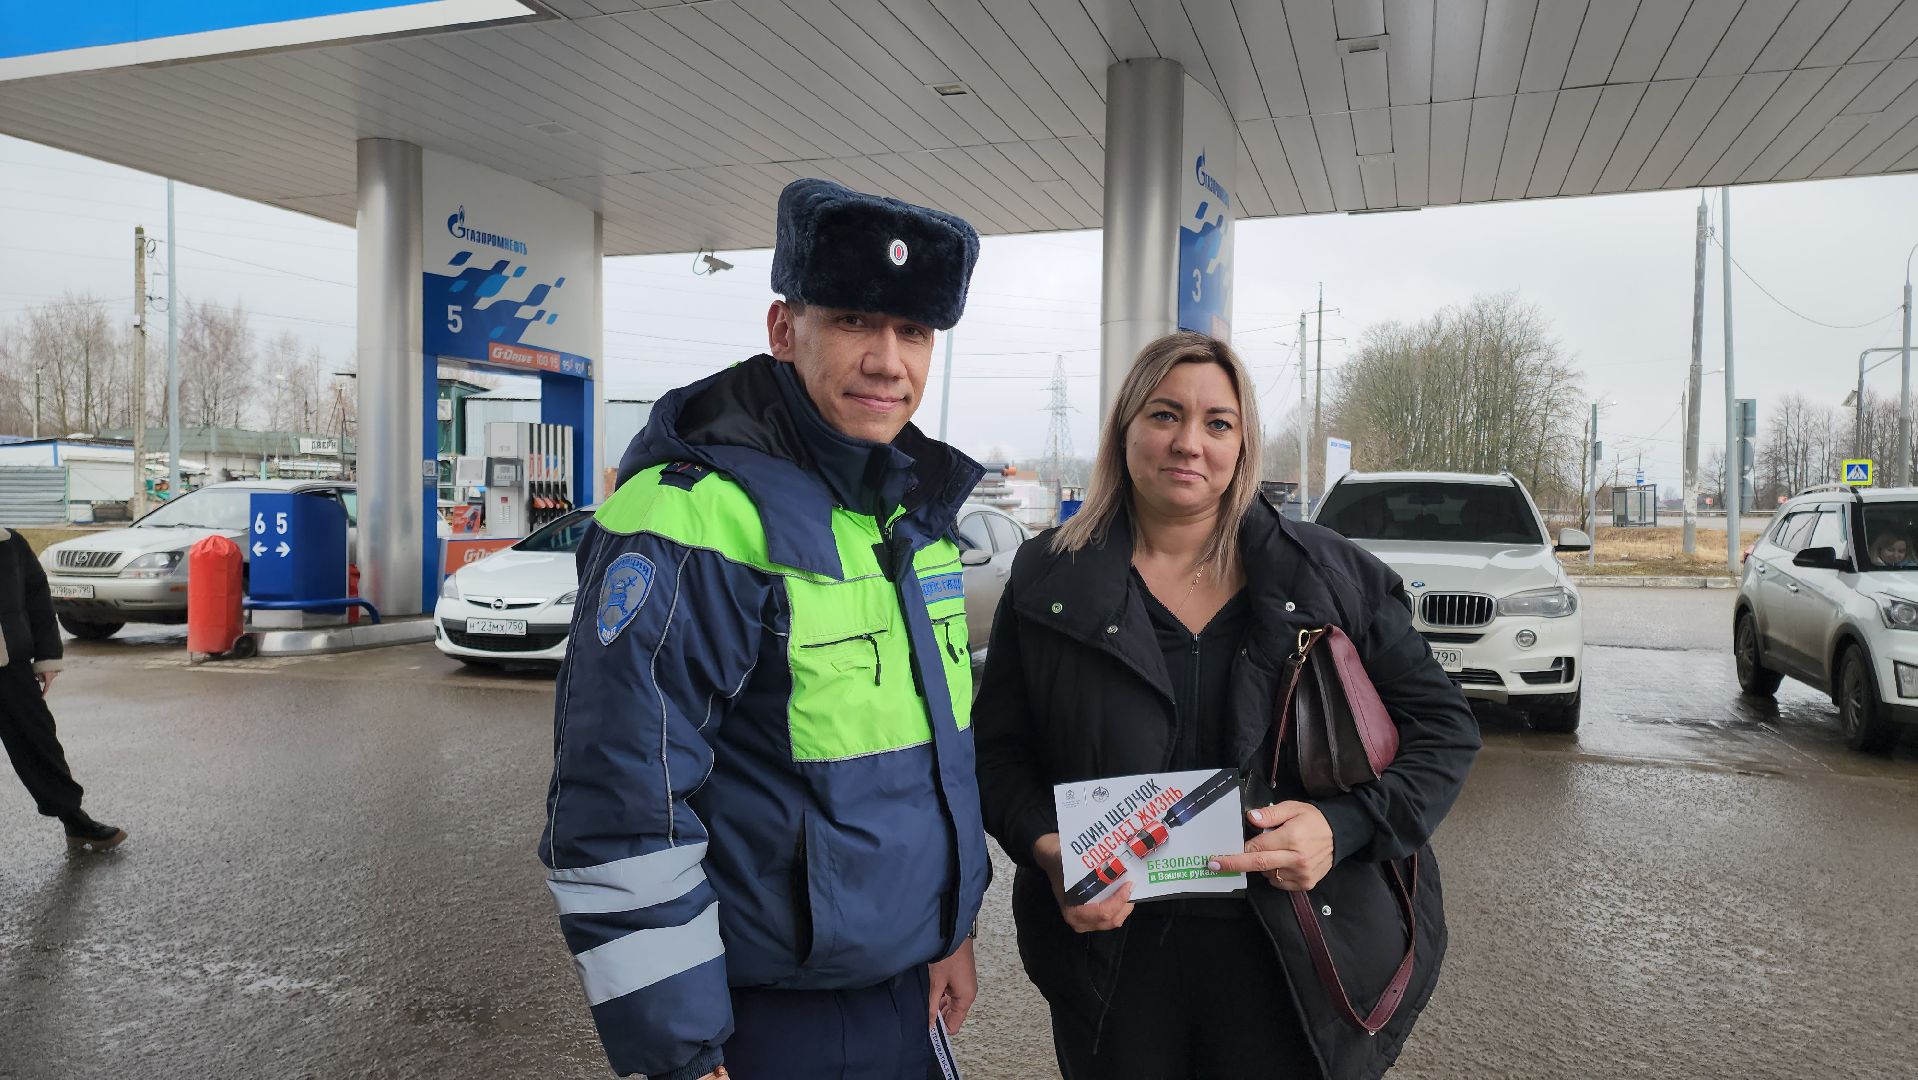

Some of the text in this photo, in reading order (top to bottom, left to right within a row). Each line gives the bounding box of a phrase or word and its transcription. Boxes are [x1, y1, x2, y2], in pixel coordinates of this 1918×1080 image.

[466, 228, 528, 256] ГАЗПРОМНЕФТЬ
[1192, 268, 1202, 303] 3
[447, 304, 463, 334] 5
[254, 511, 288, 535] 6 5
[508, 622, 524, 631] 750
[1433, 651, 1457, 663] 790
[1070, 778, 1162, 856] ОДИН ЩЕЛЧОК
[1081, 786, 1184, 869] СПАСАЕТ ЖИЗНЬ
[1147, 854, 1231, 871] БЕЗОПАСН
[1158, 871, 1188, 881] Ваших
